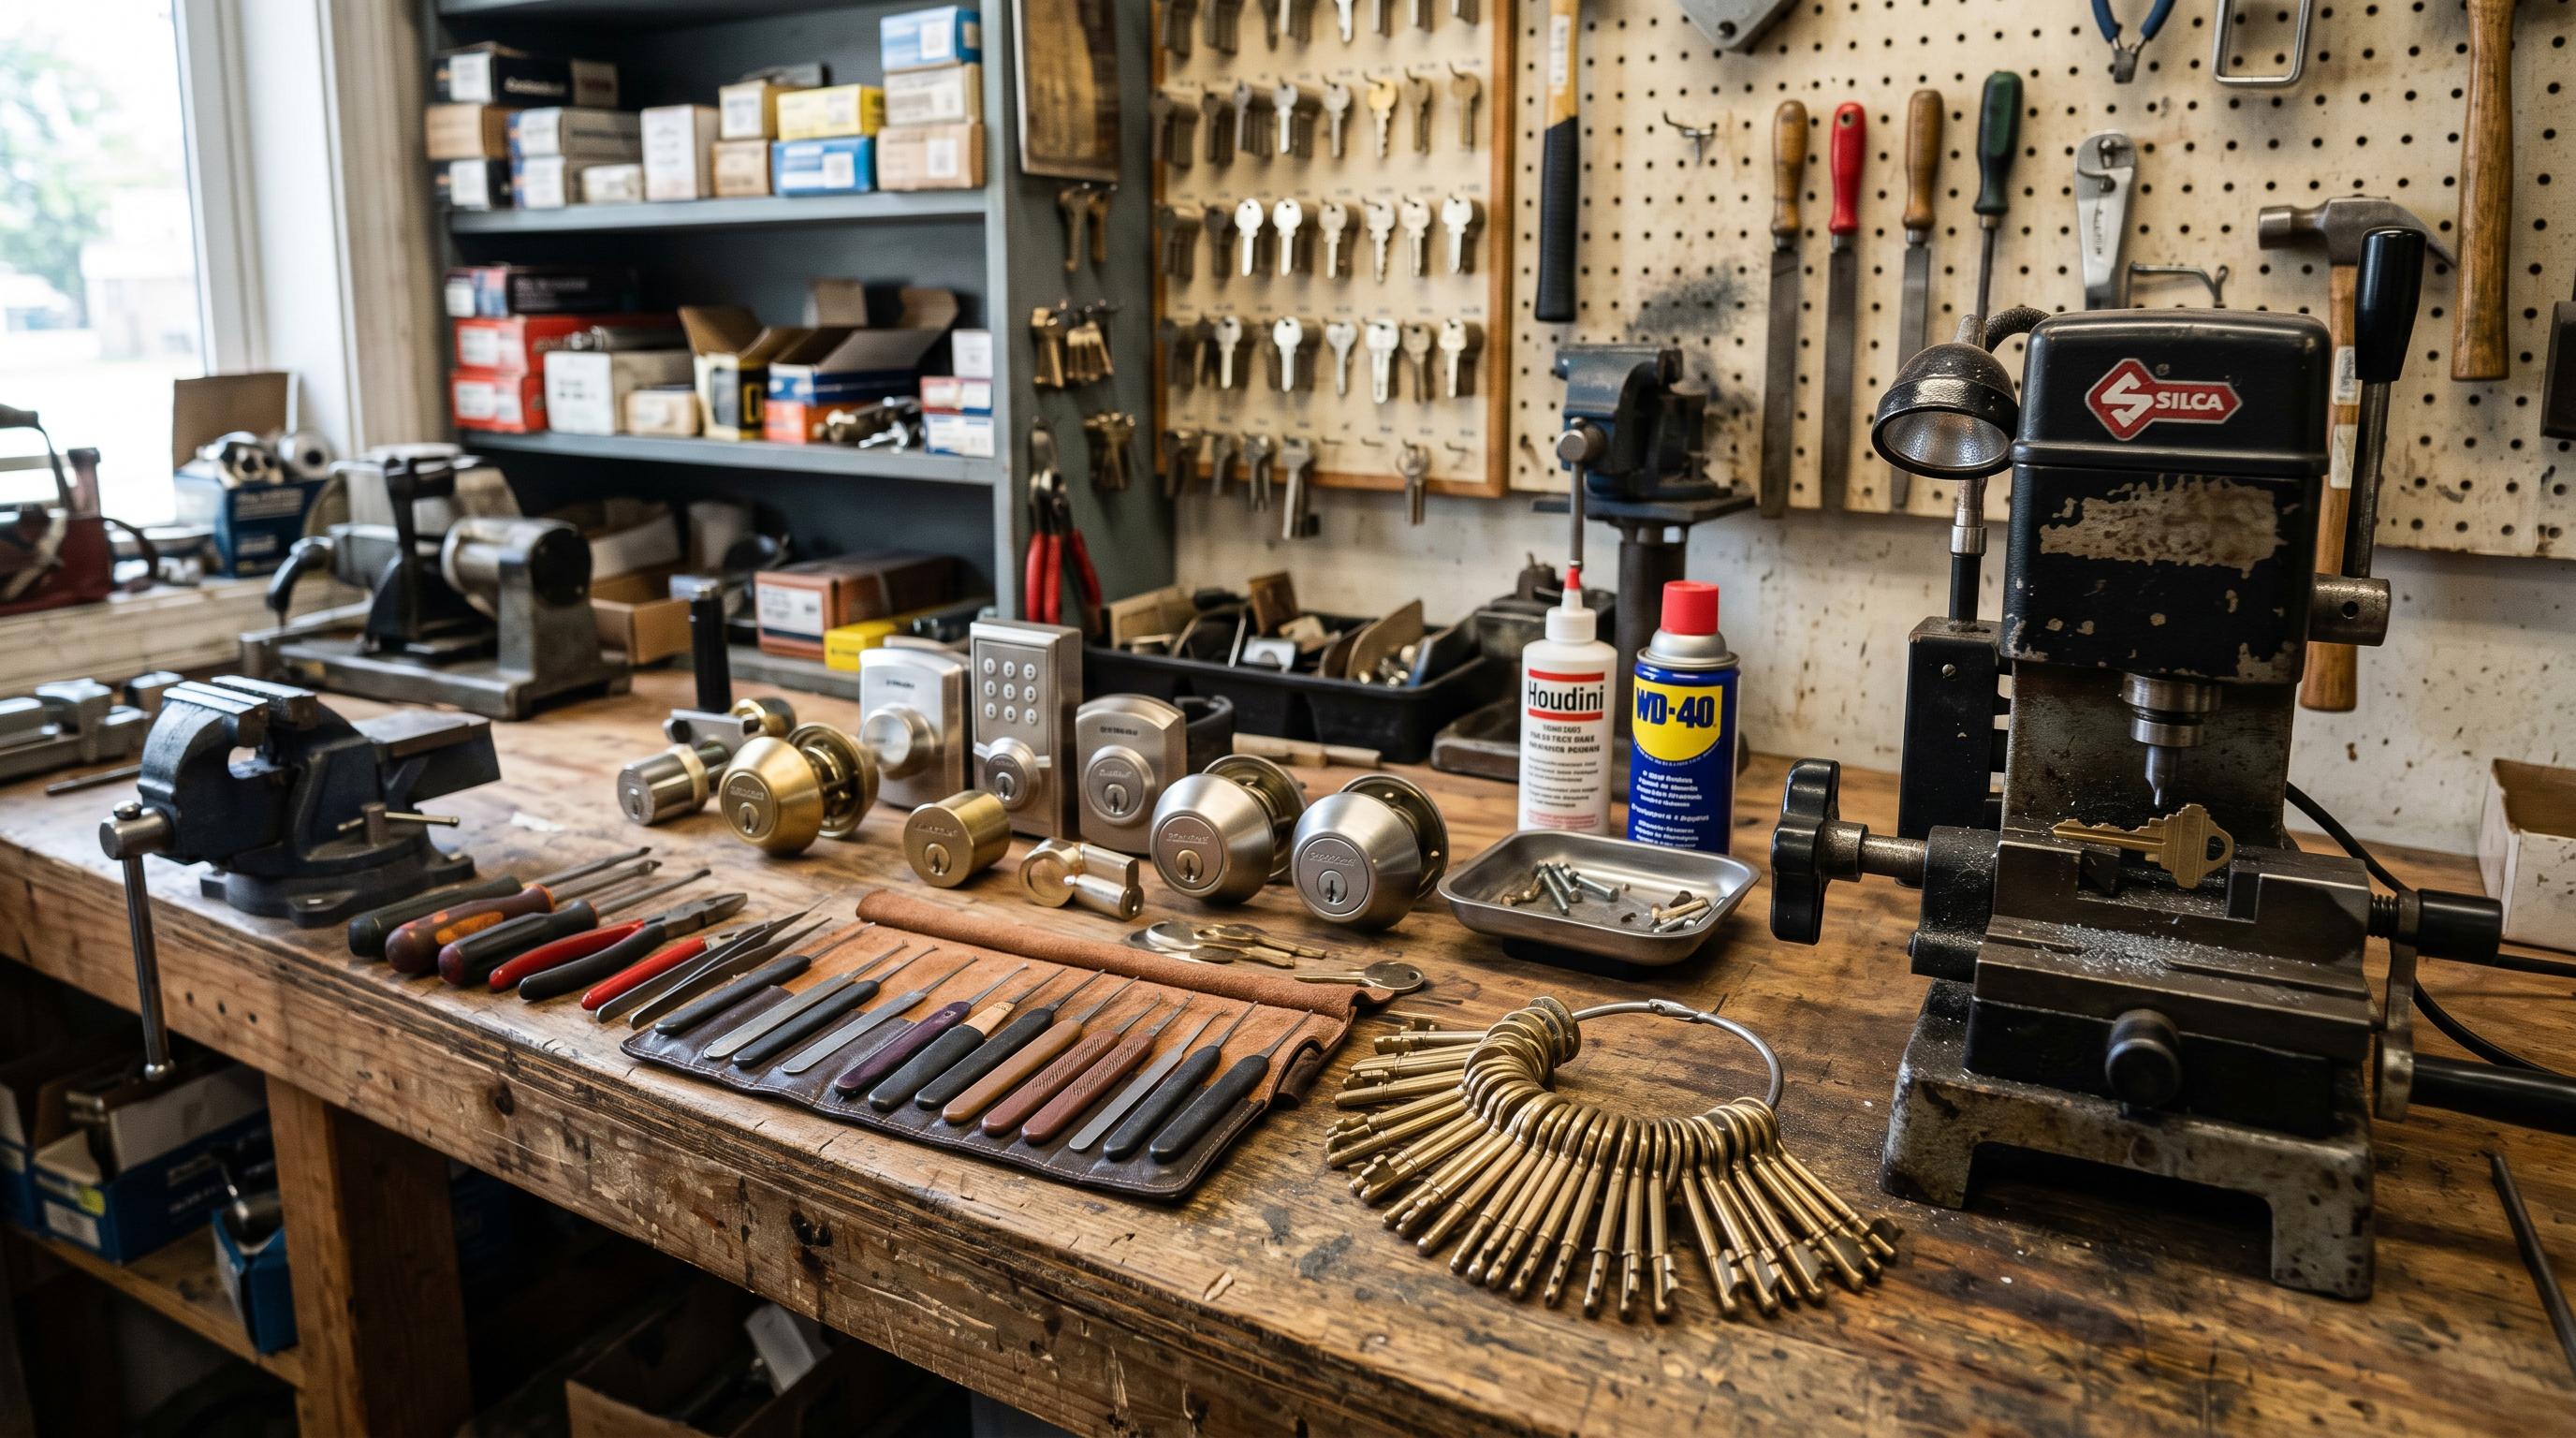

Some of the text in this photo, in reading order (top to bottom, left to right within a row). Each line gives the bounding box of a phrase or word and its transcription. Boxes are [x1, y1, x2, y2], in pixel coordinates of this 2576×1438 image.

[2156, 391, 2224, 411] SILCA
[1529, 681, 1603, 711] Houdini
[1636, 686, 1715, 728] WD-40
